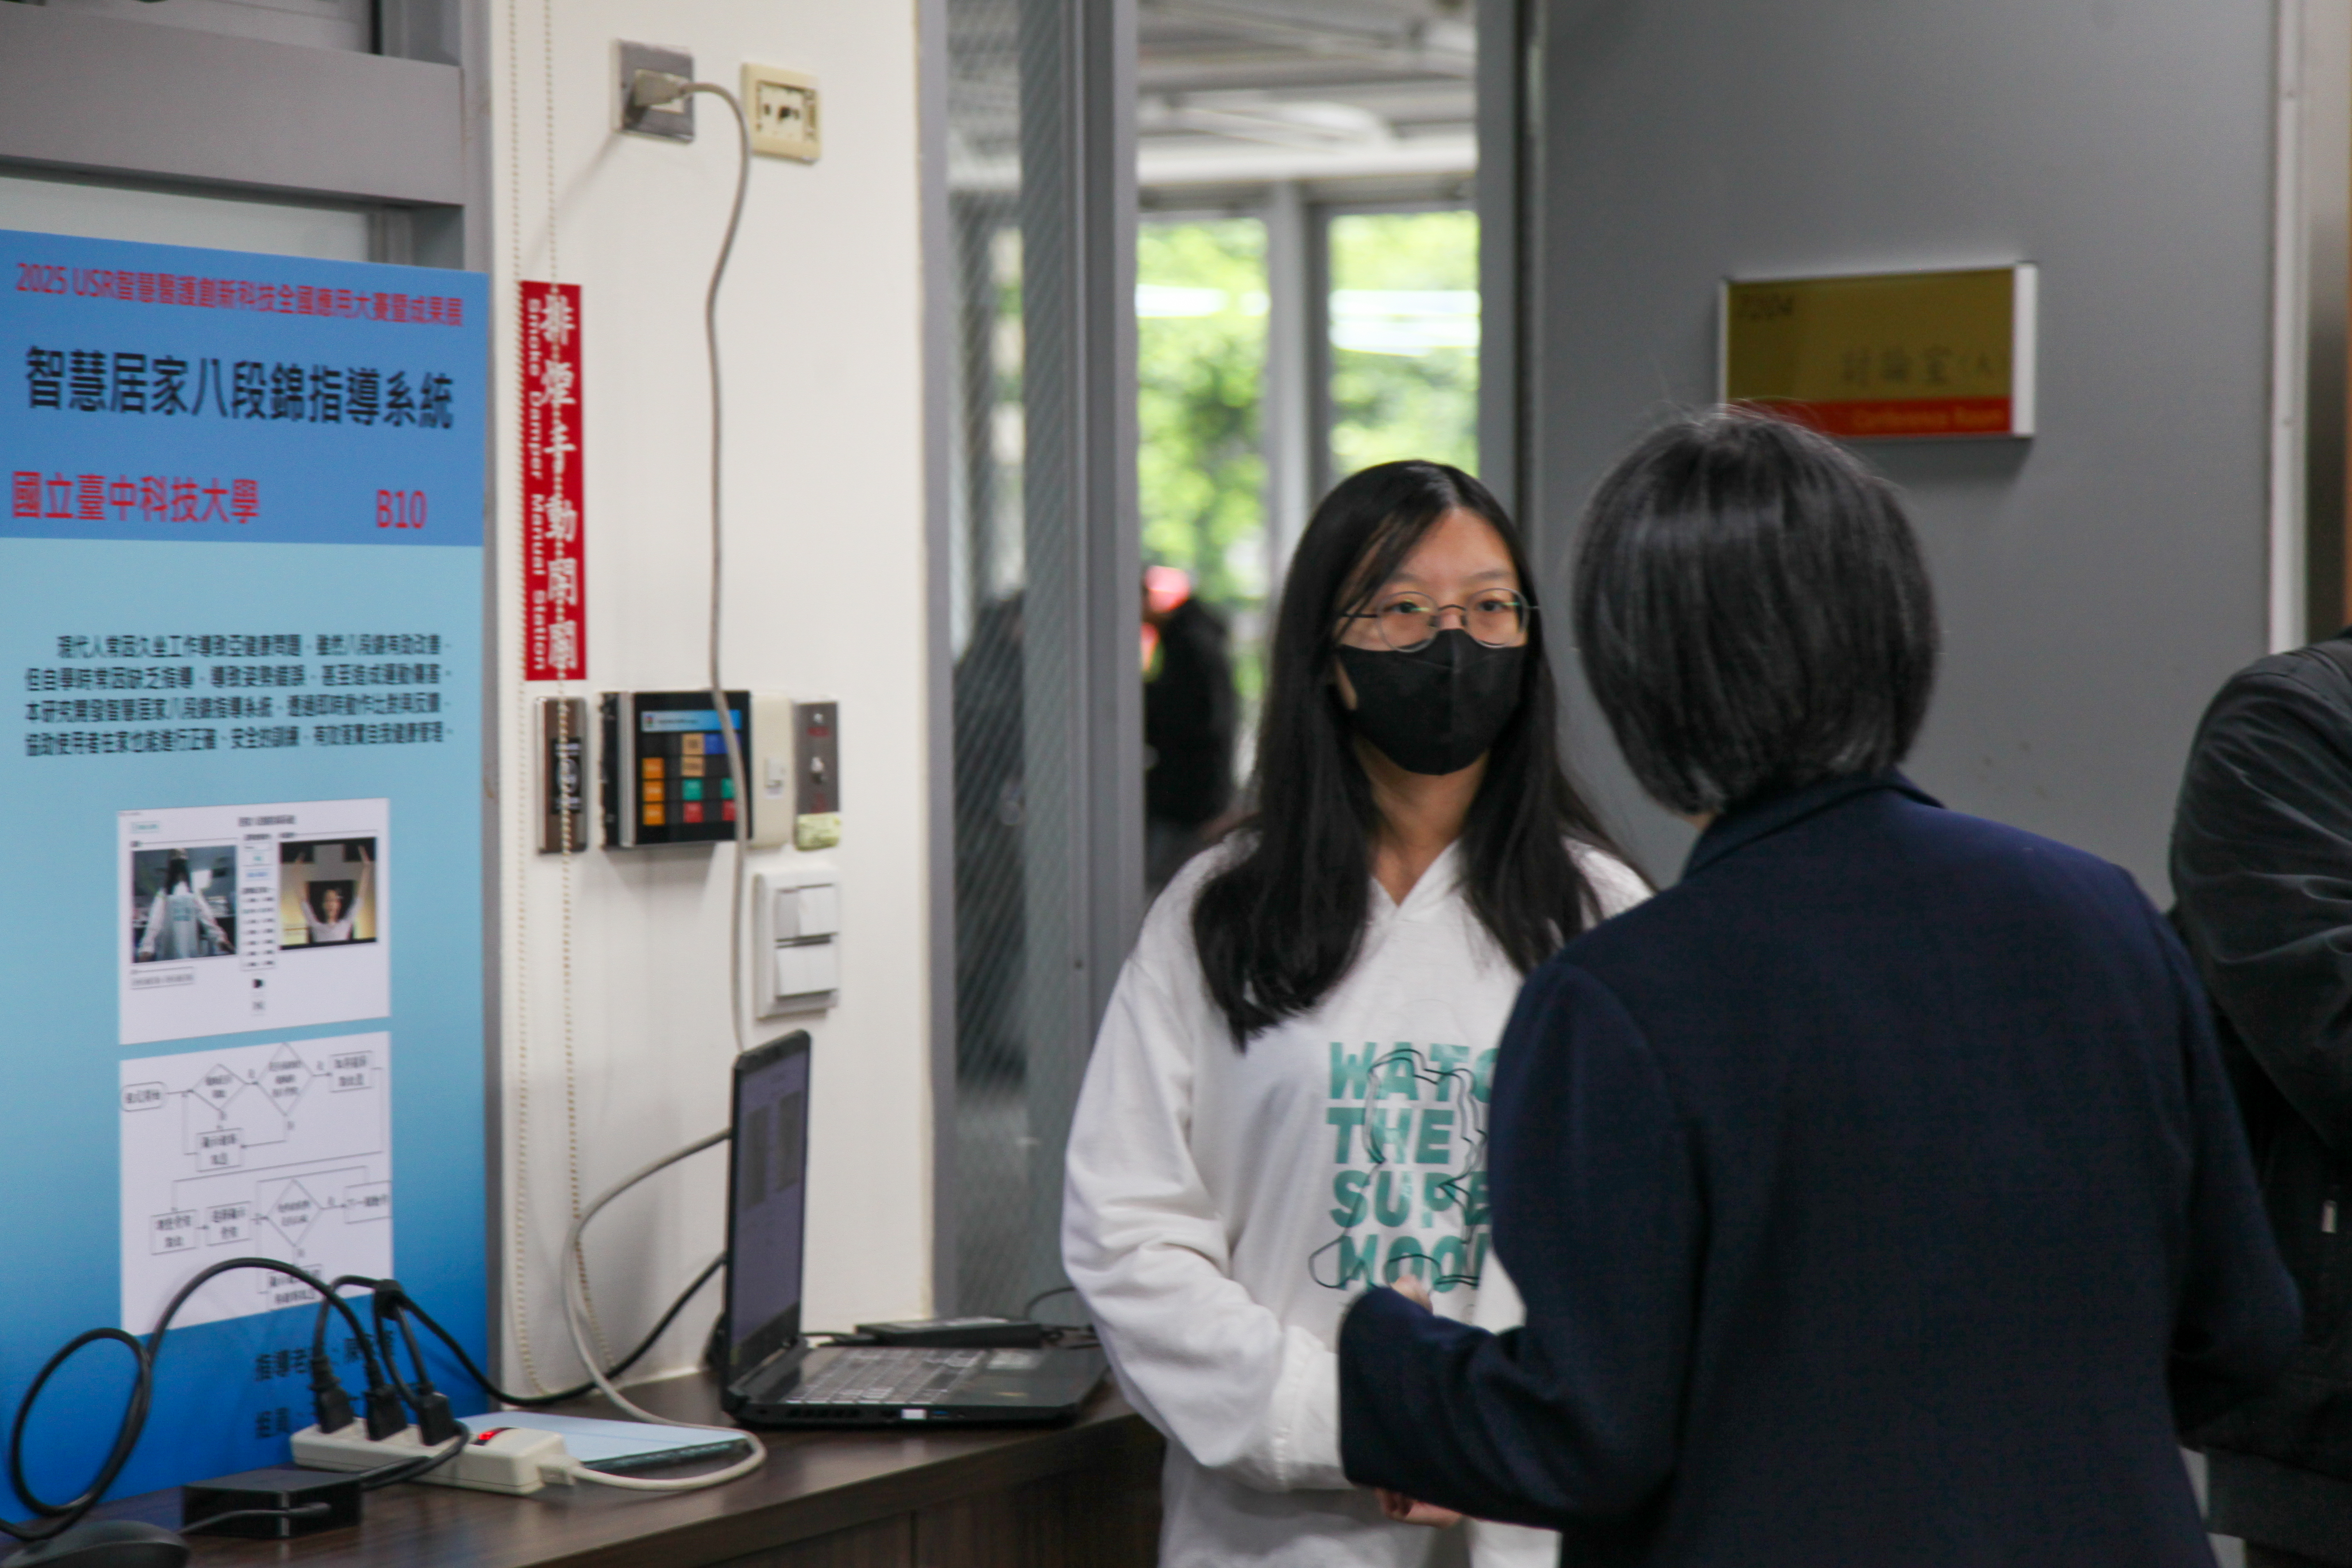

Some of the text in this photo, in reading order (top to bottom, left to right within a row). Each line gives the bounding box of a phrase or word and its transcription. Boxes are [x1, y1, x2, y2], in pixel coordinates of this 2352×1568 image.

[15, 262, 68, 294] 2025
[25, 346, 454, 429] 智慧居家八段錦指導系統
[12, 470, 428, 529] 國立臺中科技大學 B10
[527, 298, 547, 670] Smoke Damper Manual Station
[1326, 1107, 1455, 1164] THE
